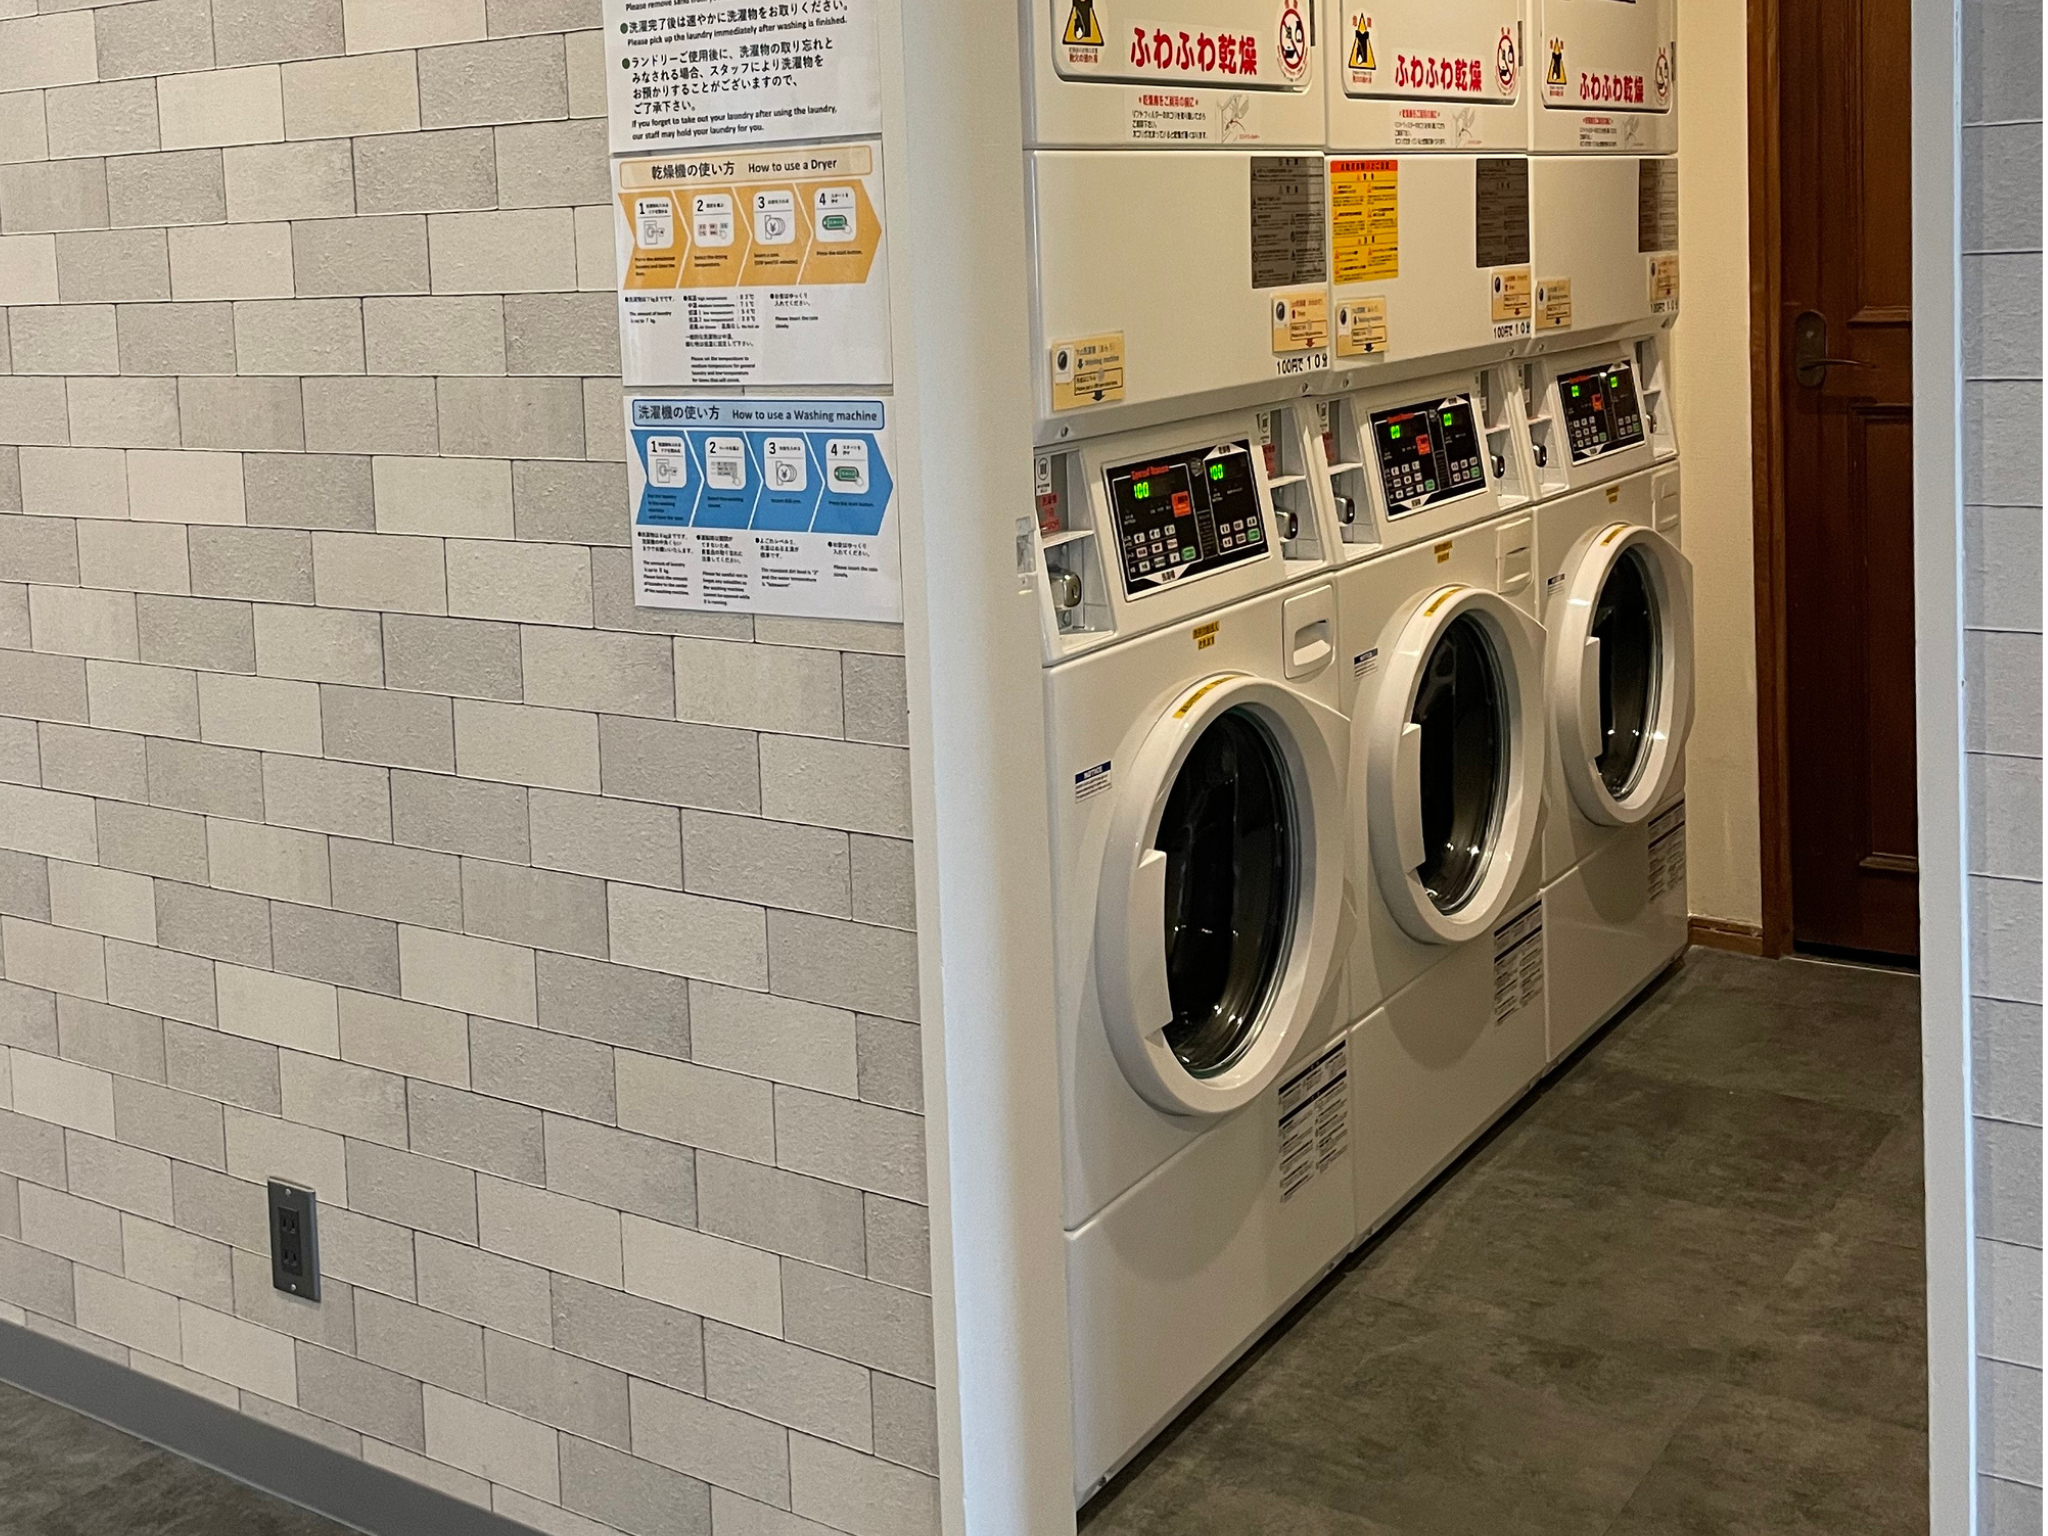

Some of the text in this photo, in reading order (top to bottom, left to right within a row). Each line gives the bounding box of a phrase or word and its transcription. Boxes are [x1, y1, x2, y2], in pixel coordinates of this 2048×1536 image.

[626, 3, 646, 11] Please
[648, 0, 672, 8] remove
[650, 36, 662, 45] pick
[664, 36, 672, 44] up
[674, 33, 685, 41] the
[687, 30, 713, 39] laundry
[714, 25, 757, 37] immediately
[759, 24, 775, 32] after
[777, 21, 806, 30] washing
[808, 19, 814, 27] is
[816, 15, 847, 26] finished.
[1131, 27, 1257, 75] ふわふわ乾燥
[1395, 54, 1482, 92] ふわふわ乾燥
[1580, 73, 1644, 104] ふわふわ乾燥
[634, 100, 695, 115] ご了承下さい。
[652, 119, 671, 127] forget
[681, 116, 696, 124] take
[710, 114, 726, 123] your
[727, 111, 753, 120] laundry
[755, 109, 771, 118] after
[773, 107, 792, 117] using
[794, 106, 806, 115] the
[632, 132, 643, 140] our
[645, 130, 660, 139] staff
[676, 128, 692, 137] hold
[693, 128, 709, 137] your
[710, 125, 736, 134] laundry
[737, 124, 748, 132] for
[749, 124, 764, 133] you.
[652, 161, 735, 180] 乾燥機の使い方
[748, 159, 837, 173] How to use a Dryer
[697, 199, 704, 212] 2
[758, 196, 765, 209] 3
[819, 192, 826, 206] 4
[639, 202, 645, 214] 1
[638, 405, 720, 420] 洗濯機の使い方
[732, 409, 877, 423] How to use a Washing machine
[651, 440, 658, 453] 1
[709, 441, 716, 454] 2
[769, 442, 776, 455] 3
[831, 443, 838, 456] 4
[1133, 482, 1149, 499] 100
